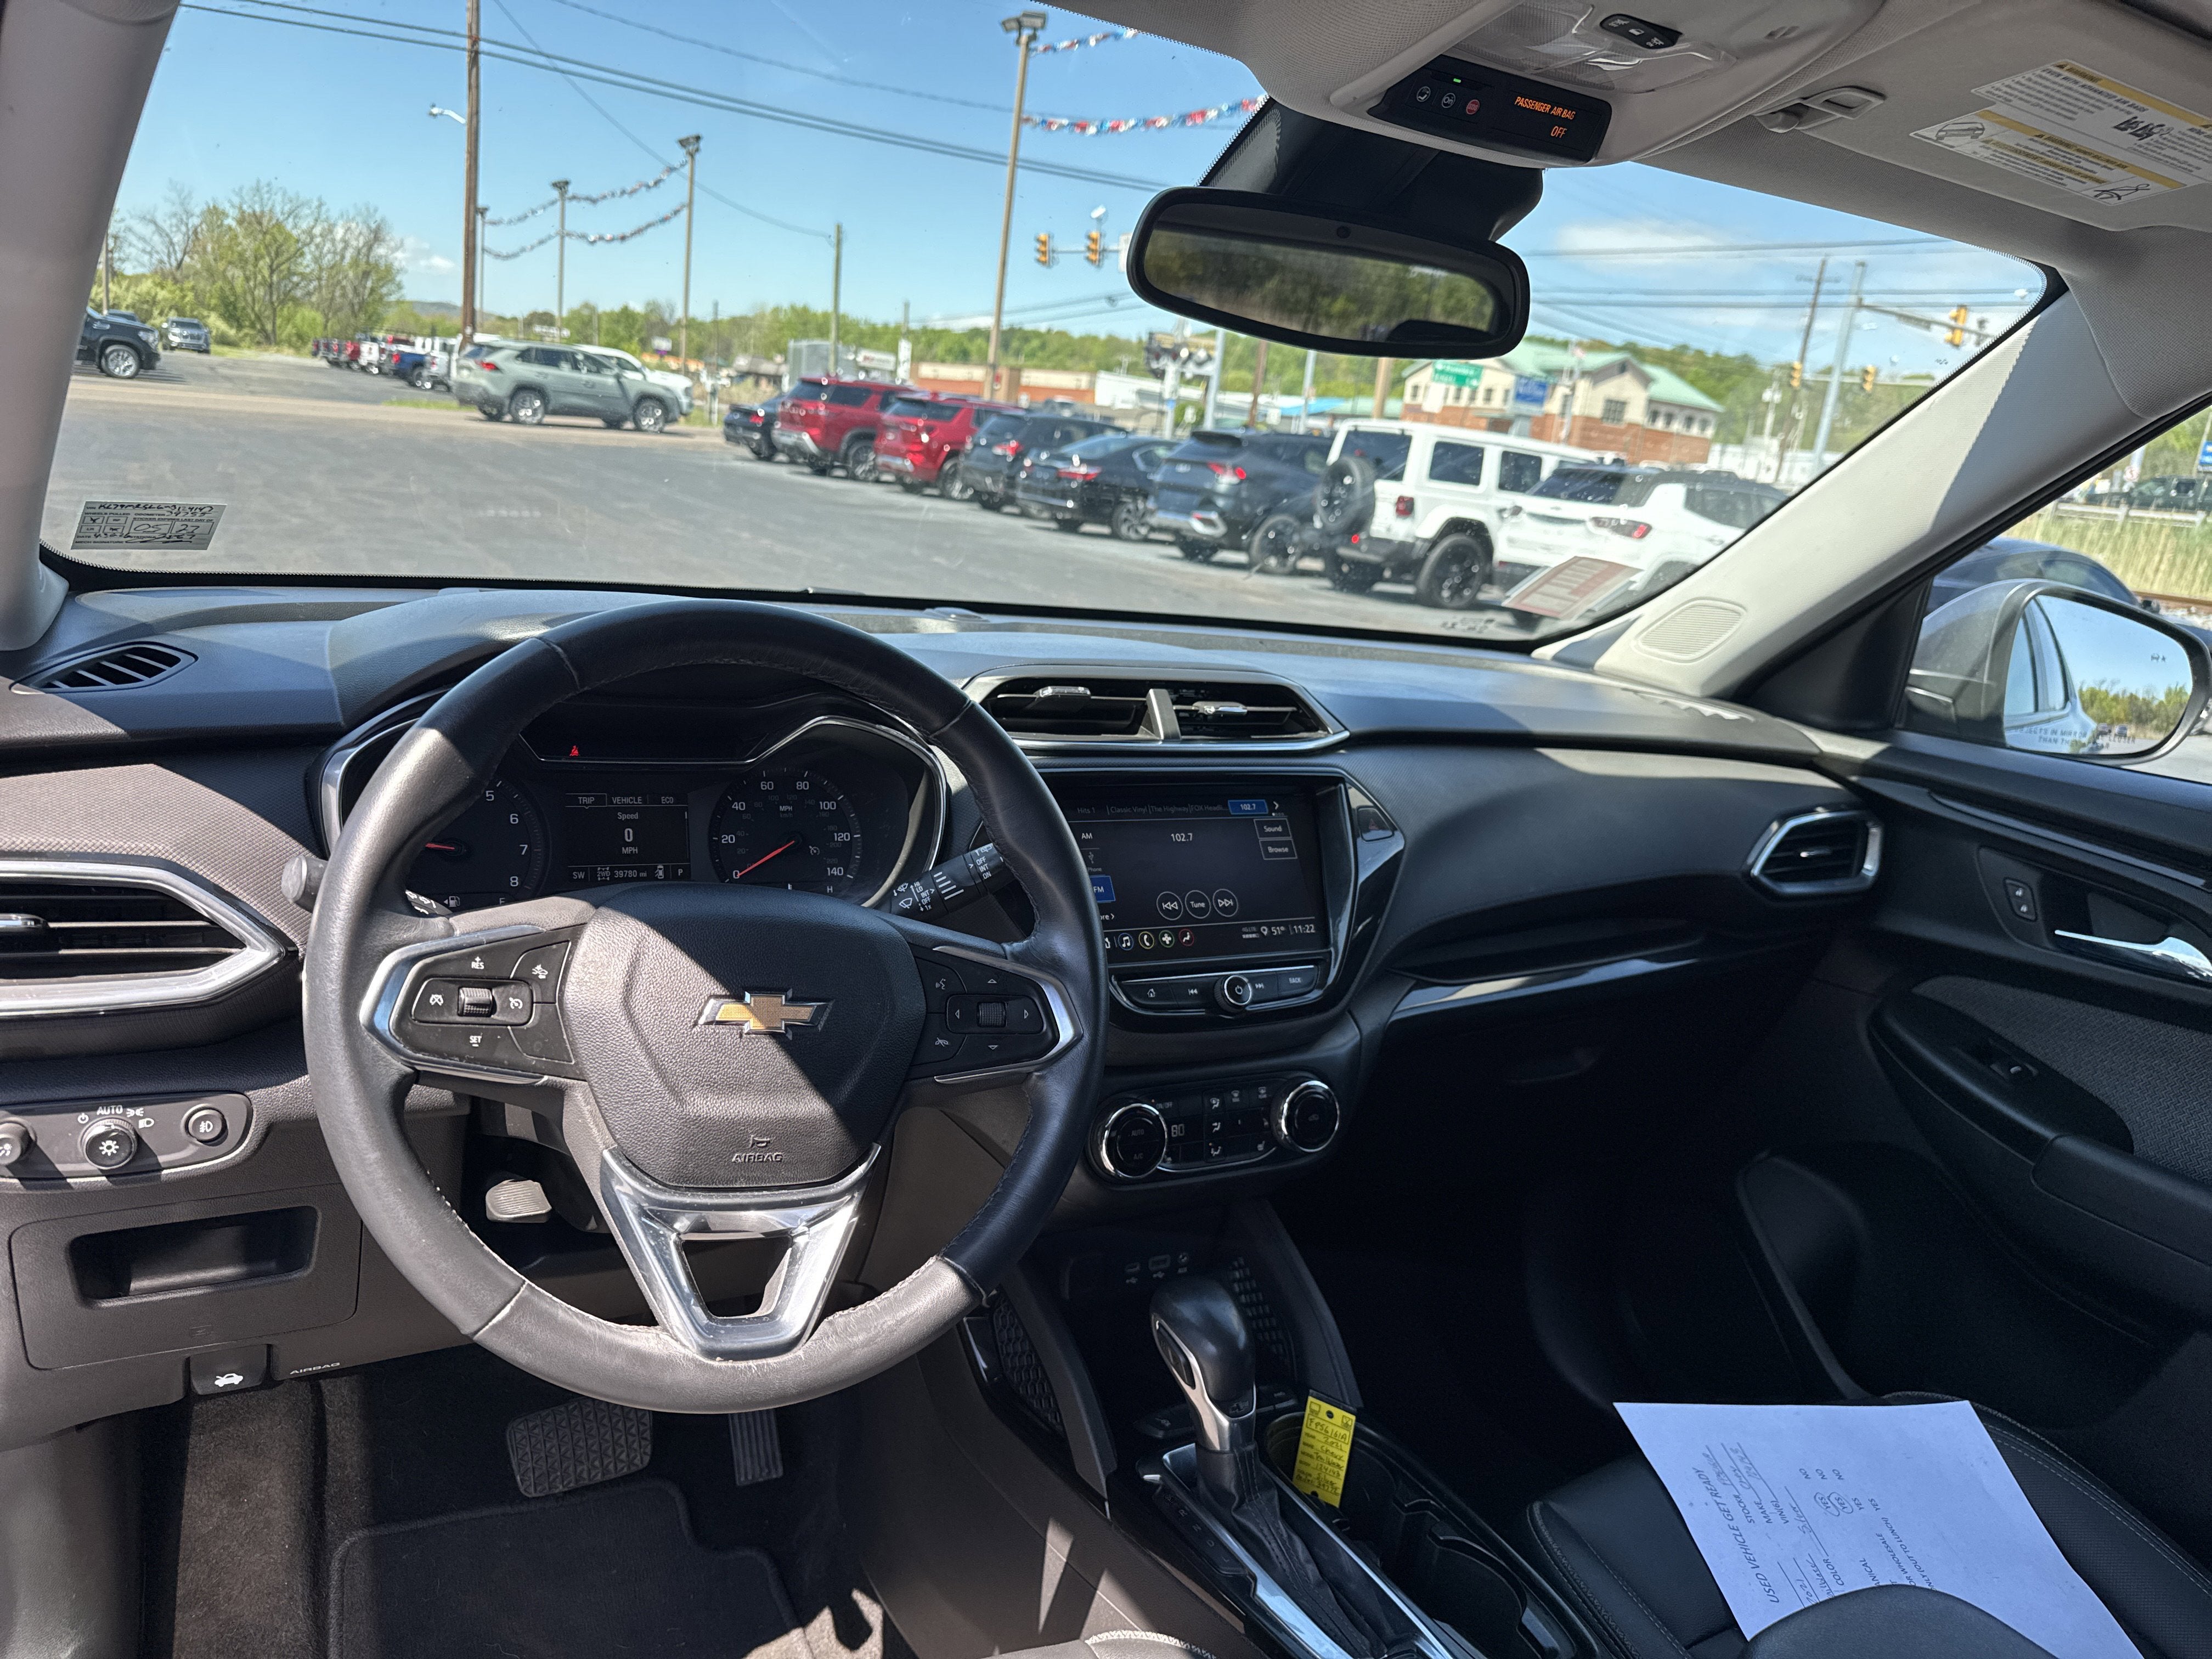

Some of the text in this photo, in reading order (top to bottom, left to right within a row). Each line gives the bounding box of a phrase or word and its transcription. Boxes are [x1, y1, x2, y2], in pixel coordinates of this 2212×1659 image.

[1514, 96, 1576, 120] PASSENGER AIR BAG
[1550, 126, 1567, 138] OFF
[760, 781, 774, 791] 60
[796, 781, 809, 790] 80
[486, 790, 494, 802] 5
[732, 802, 746, 811] 40
[819, 801, 837, 810] 100
[1110, 805, 1148, 814] Classic Vinyl
[1163, 805, 1189, 814] Highway
[510, 813, 519, 824] 6
[617, 812, 639, 821] Speed
[624, 827, 634, 843] 0
[721, 834, 735, 844] 20
[834, 832, 850, 842] 120
[1171, 833, 1193, 842] 102.7
[519, 844, 528, 856] 7
[622, 847, 638, 855] MPH
[975, 856, 987, 865] OFF
[732, 870, 740, 879] 0
[827, 867, 844, 877] 140
[979, 864, 989, 873] INT
[510, 876, 519, 887] 8
[983, 871, 992, 880] ON
[921, 896, 932, 905] OFF
[1294, 924, 1316, 933] 11:22
[469, 1035, 482, 1043] SET
[97, 1105, 123, 1115] AUTO
[1131, 1128, 1144, 1137] AUTO
[731, 1152, 784, 1164] AIRBAG
[290, 1362, 340, 1375] AIRBAG
[1815, 1468, 1828, 1480] NO
[1832, 1468, 1845, 1481] NO
[1692, 1466, 1722, 1499] READY
[1834, 1496, 1848, 1510] YES
[1852, 1497, 1865, 1511] YES
[1868, 1498, 1881, 1511] YES
[1715, 1500, 1734, 1522] GET
[1753, 1500, 1773, 1524] MAKE
[1771, 1500, 1789, 1525] VIN(6)
[1799, 1468, 1881, 1586] ANICAL YES NO
[1881, 1516, 1903, 1543] LUNCH)
[1728, 1523, 1760, 1569] VEHICLE
[1900, 1543, 1911, 1555] TO
[1875, 1532, 1908, 1574] WHOLESALE
[1908, 1555, 1924, 1576] (OUT
[1823, 1558, 1844, 1586] COLOR
[1756, 1572, 1780, 1603] USED
